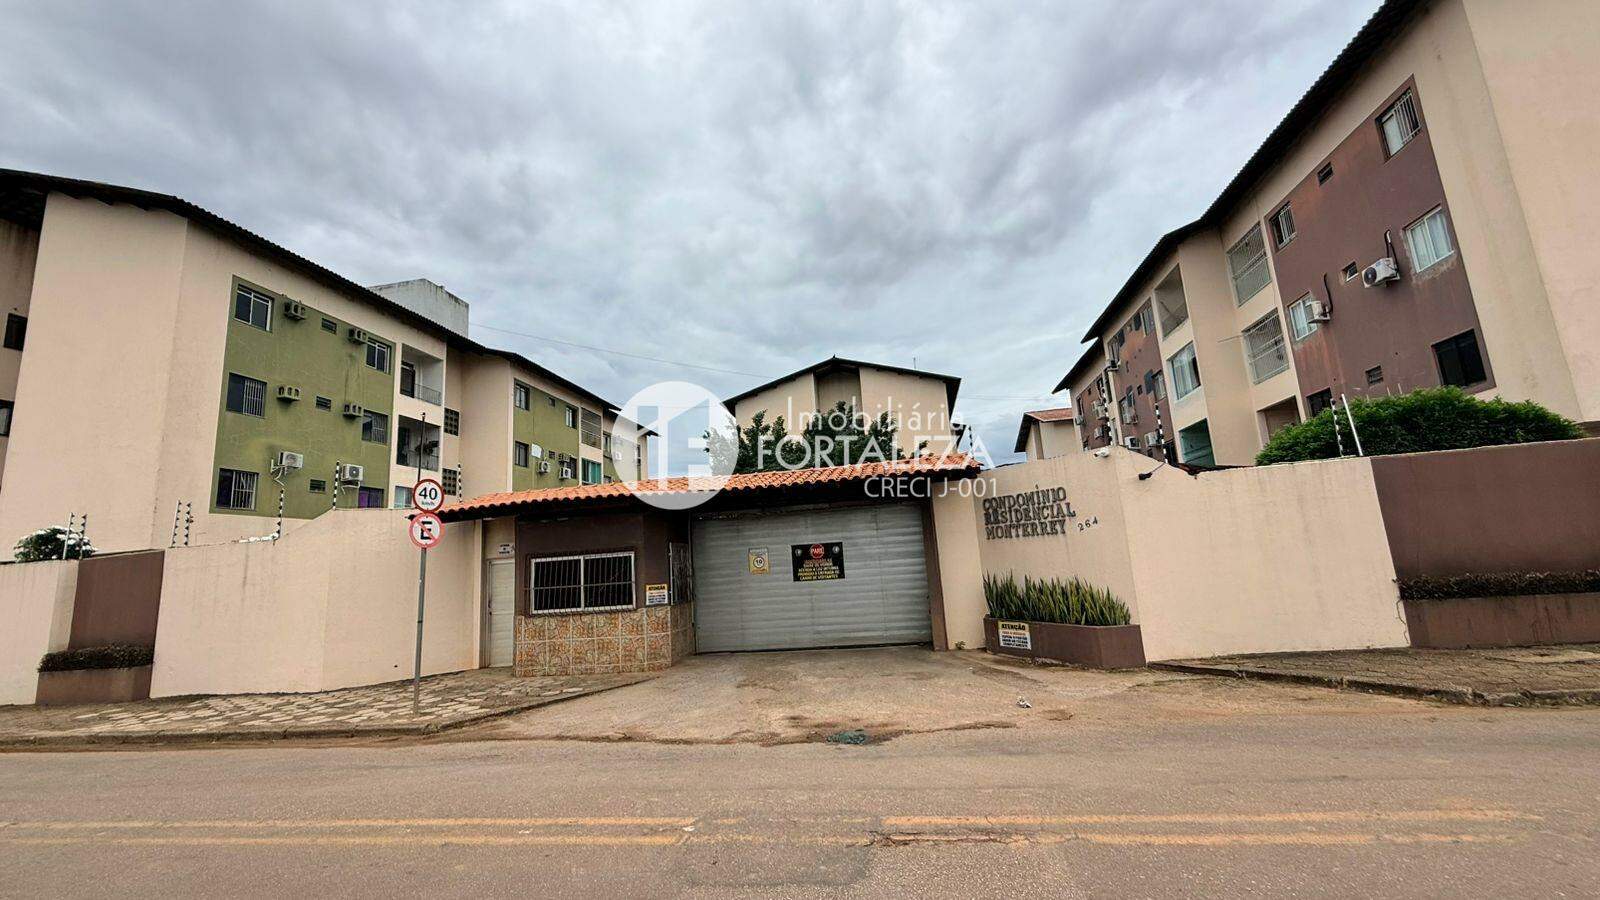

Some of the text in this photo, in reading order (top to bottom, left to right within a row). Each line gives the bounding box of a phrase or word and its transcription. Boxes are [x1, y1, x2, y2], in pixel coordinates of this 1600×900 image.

[419, 487, 438, 500] 40
[983, 484, 1067, 511] CONDOMÍNIO
[984, 502, 1076, 526] RESIDENCIAL
[420, 521, 433, 540] E
[985, 519, 1066, 540] MONTERREY
[1002, 623, 1026, 631] ATENÇÃO
